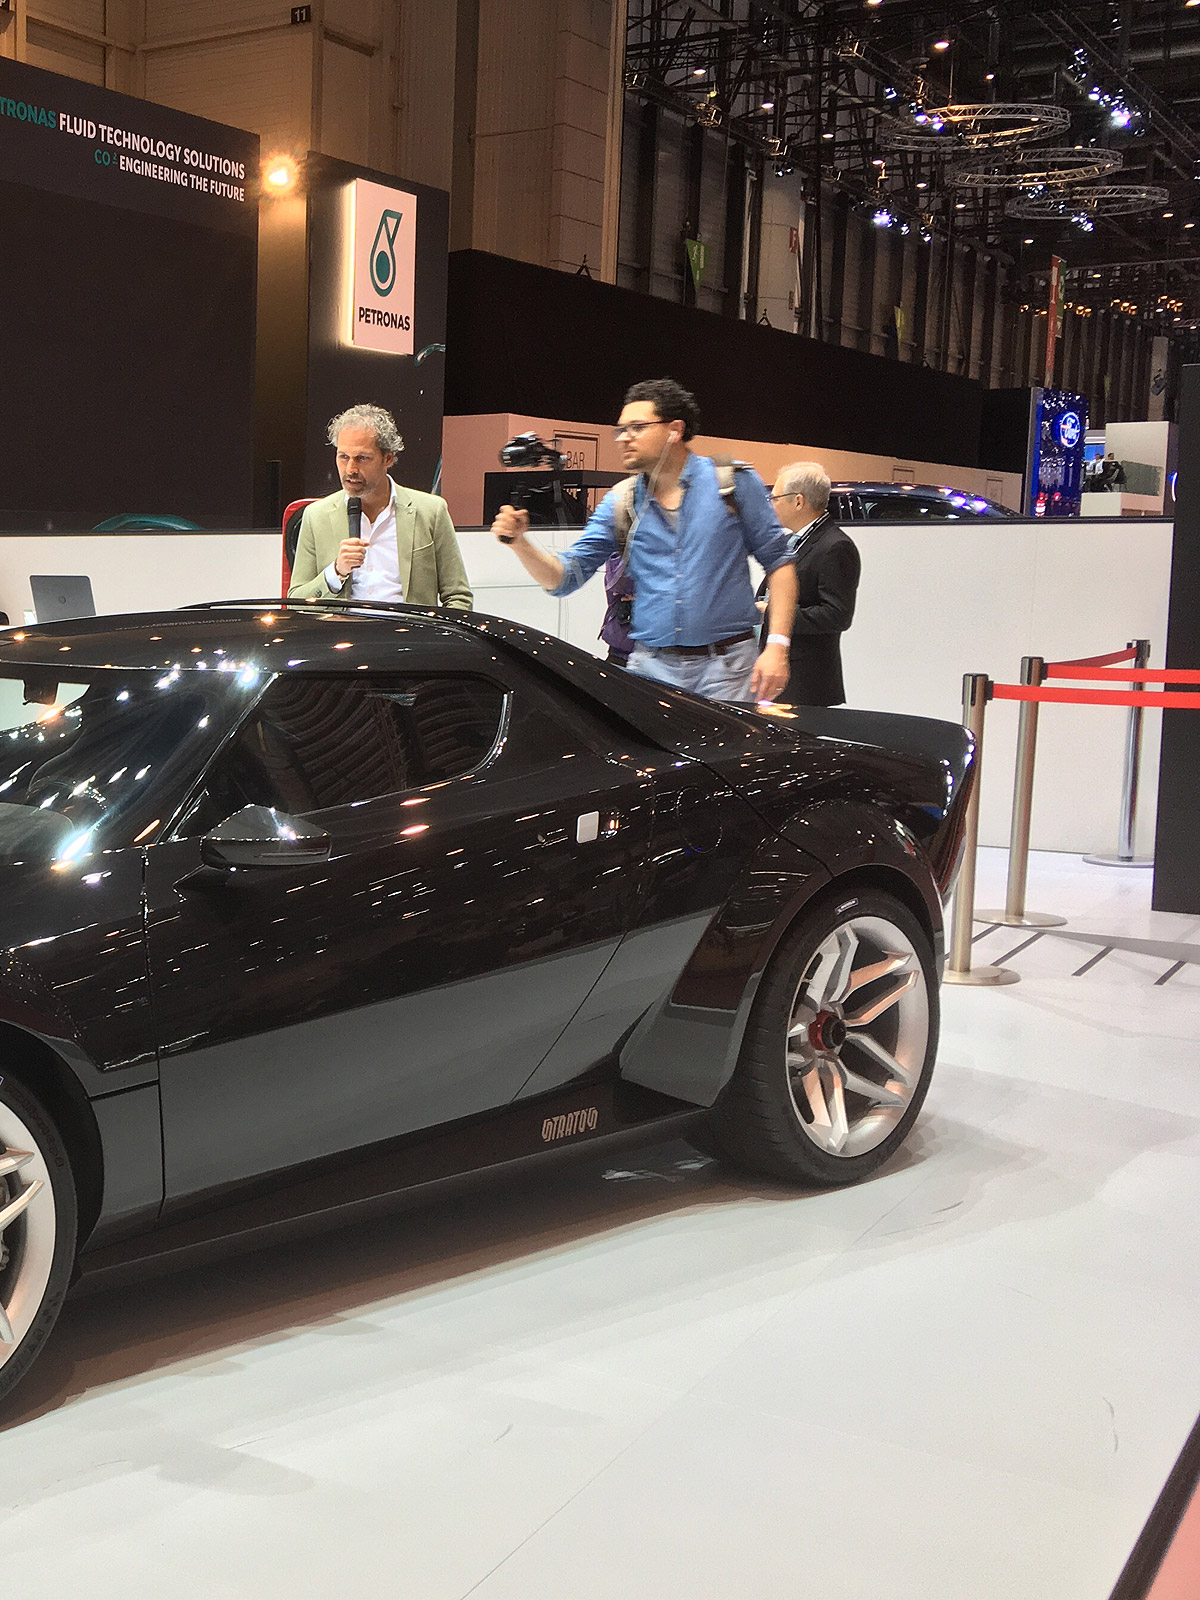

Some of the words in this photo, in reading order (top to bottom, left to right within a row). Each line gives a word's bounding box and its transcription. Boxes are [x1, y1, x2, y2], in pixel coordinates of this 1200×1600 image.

[294, 8, 306, 22] 11
[59, 112, 96, 139] FLUID
[98, 123, 182, 162] TECHNOLOGY
[183, 148, 245, 180] SOLUTIONS
[119, 154, 188, 187] ENGINEERING
[189, 174, 208, 193] THE
[209, 180, 245, 202] FUTURE
[358, 306, 411, 331] PETRONAS
[566, 450, 585, 470] BAR
